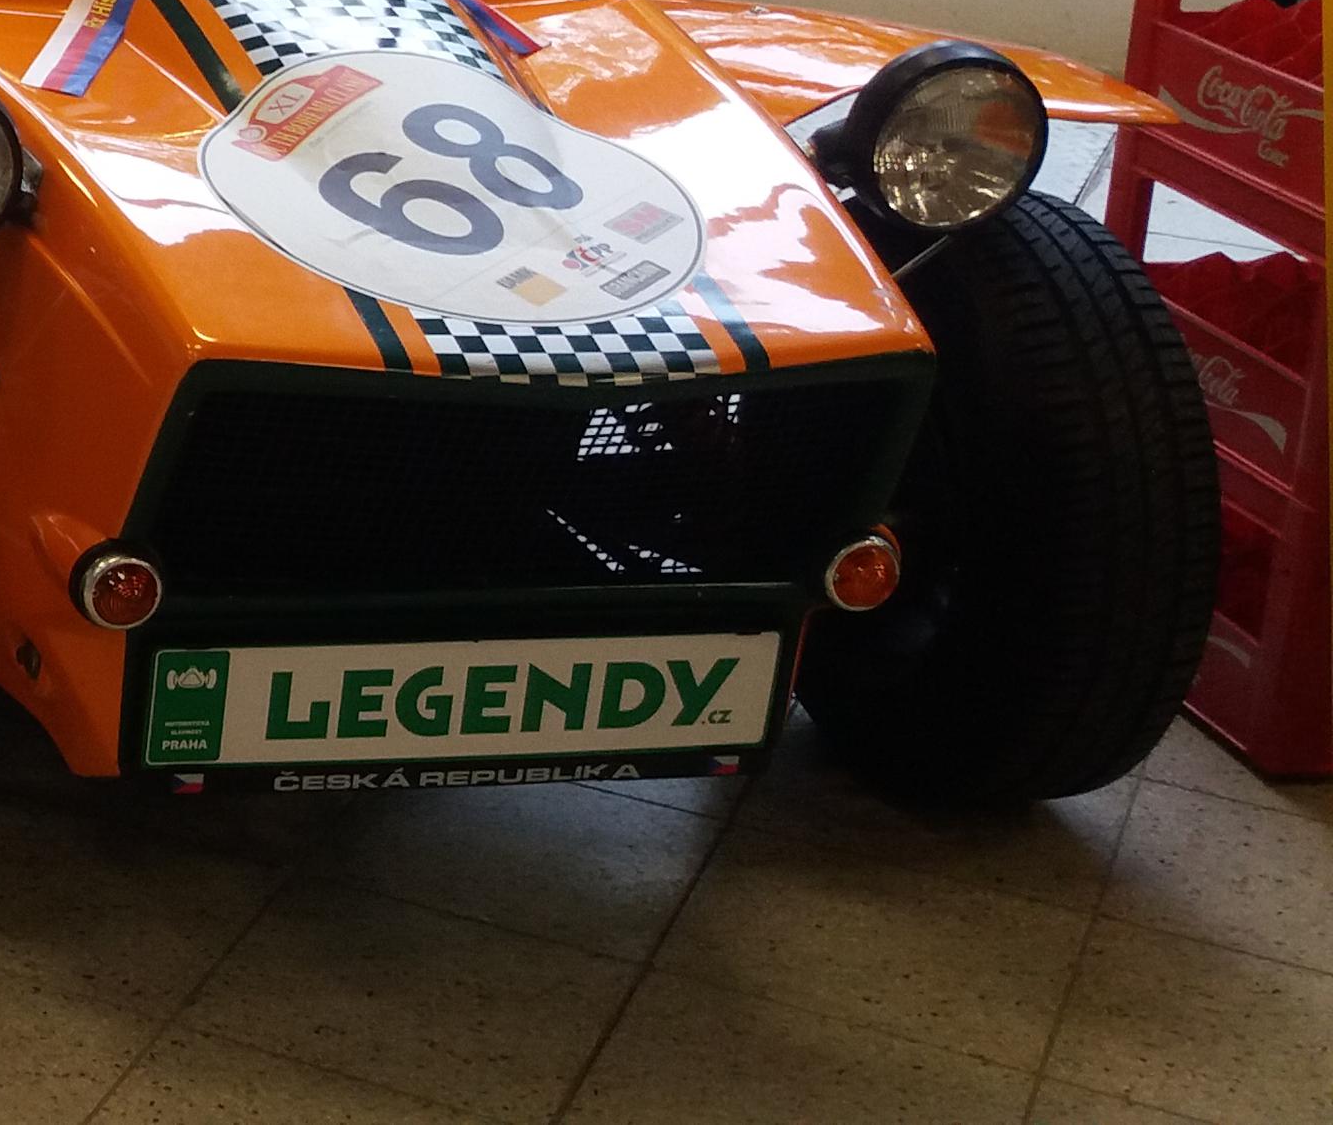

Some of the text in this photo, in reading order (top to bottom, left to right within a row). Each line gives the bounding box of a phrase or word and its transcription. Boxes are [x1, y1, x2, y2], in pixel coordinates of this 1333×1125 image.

[1197, 65, 1292, 141] Coca-Cola
[319, 103, 584, 256] 68
[161, 739, 208, 750] PRAHA
[273, 763, 642, 792] ČESKÁ REPUBLIKA
